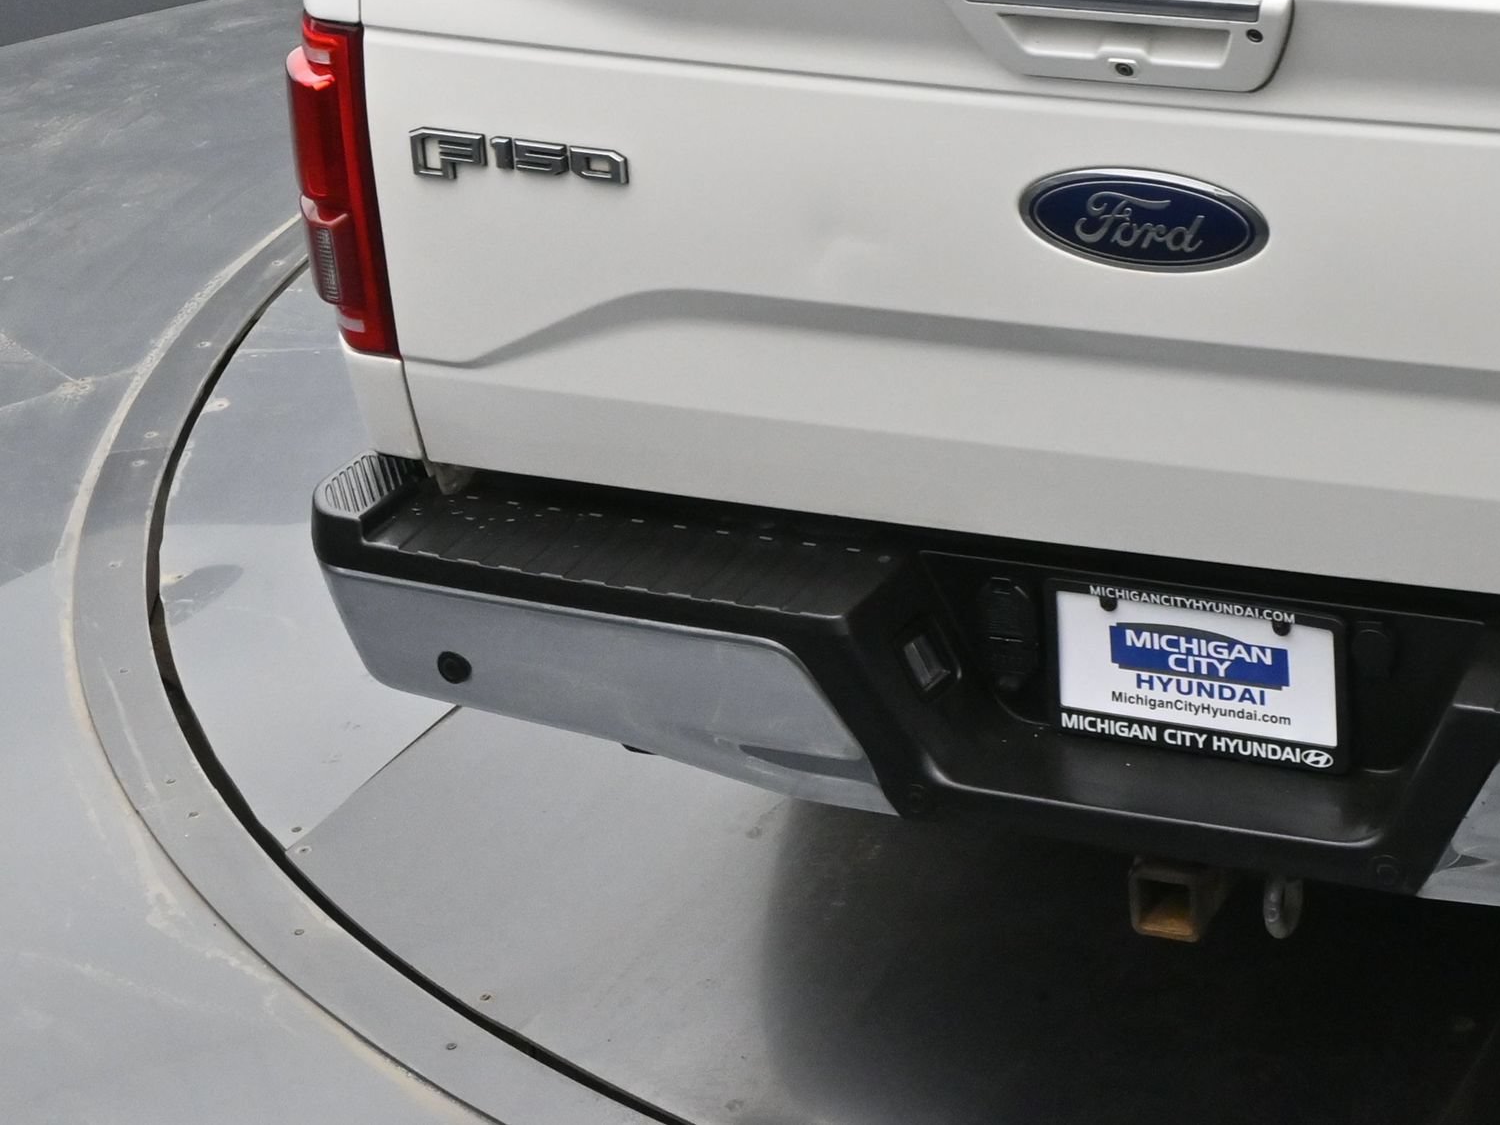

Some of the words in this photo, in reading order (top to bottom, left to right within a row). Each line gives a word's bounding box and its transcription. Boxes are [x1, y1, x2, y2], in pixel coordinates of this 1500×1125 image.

[408, 126, 629, 185] F150
[1074, 191, 1205, 253] Ford
[1089, 585, 1296, 624] MICHIGANCITYHYUNDAI.COM
[1125, 629, 1273, 665] MICHIGAN
[1168, 654, 1232, 677] CITY
[1111, 690, 1291, 726] MichiganCityHyundai.com
[1136, 673, 1266, 706] HYUNDAI
[1061, 712, 1157, 742] MICHIGAN
[1164, 728, 1207, 750] CITY
[1213, 736, 1301, 763] HYUNDAI
